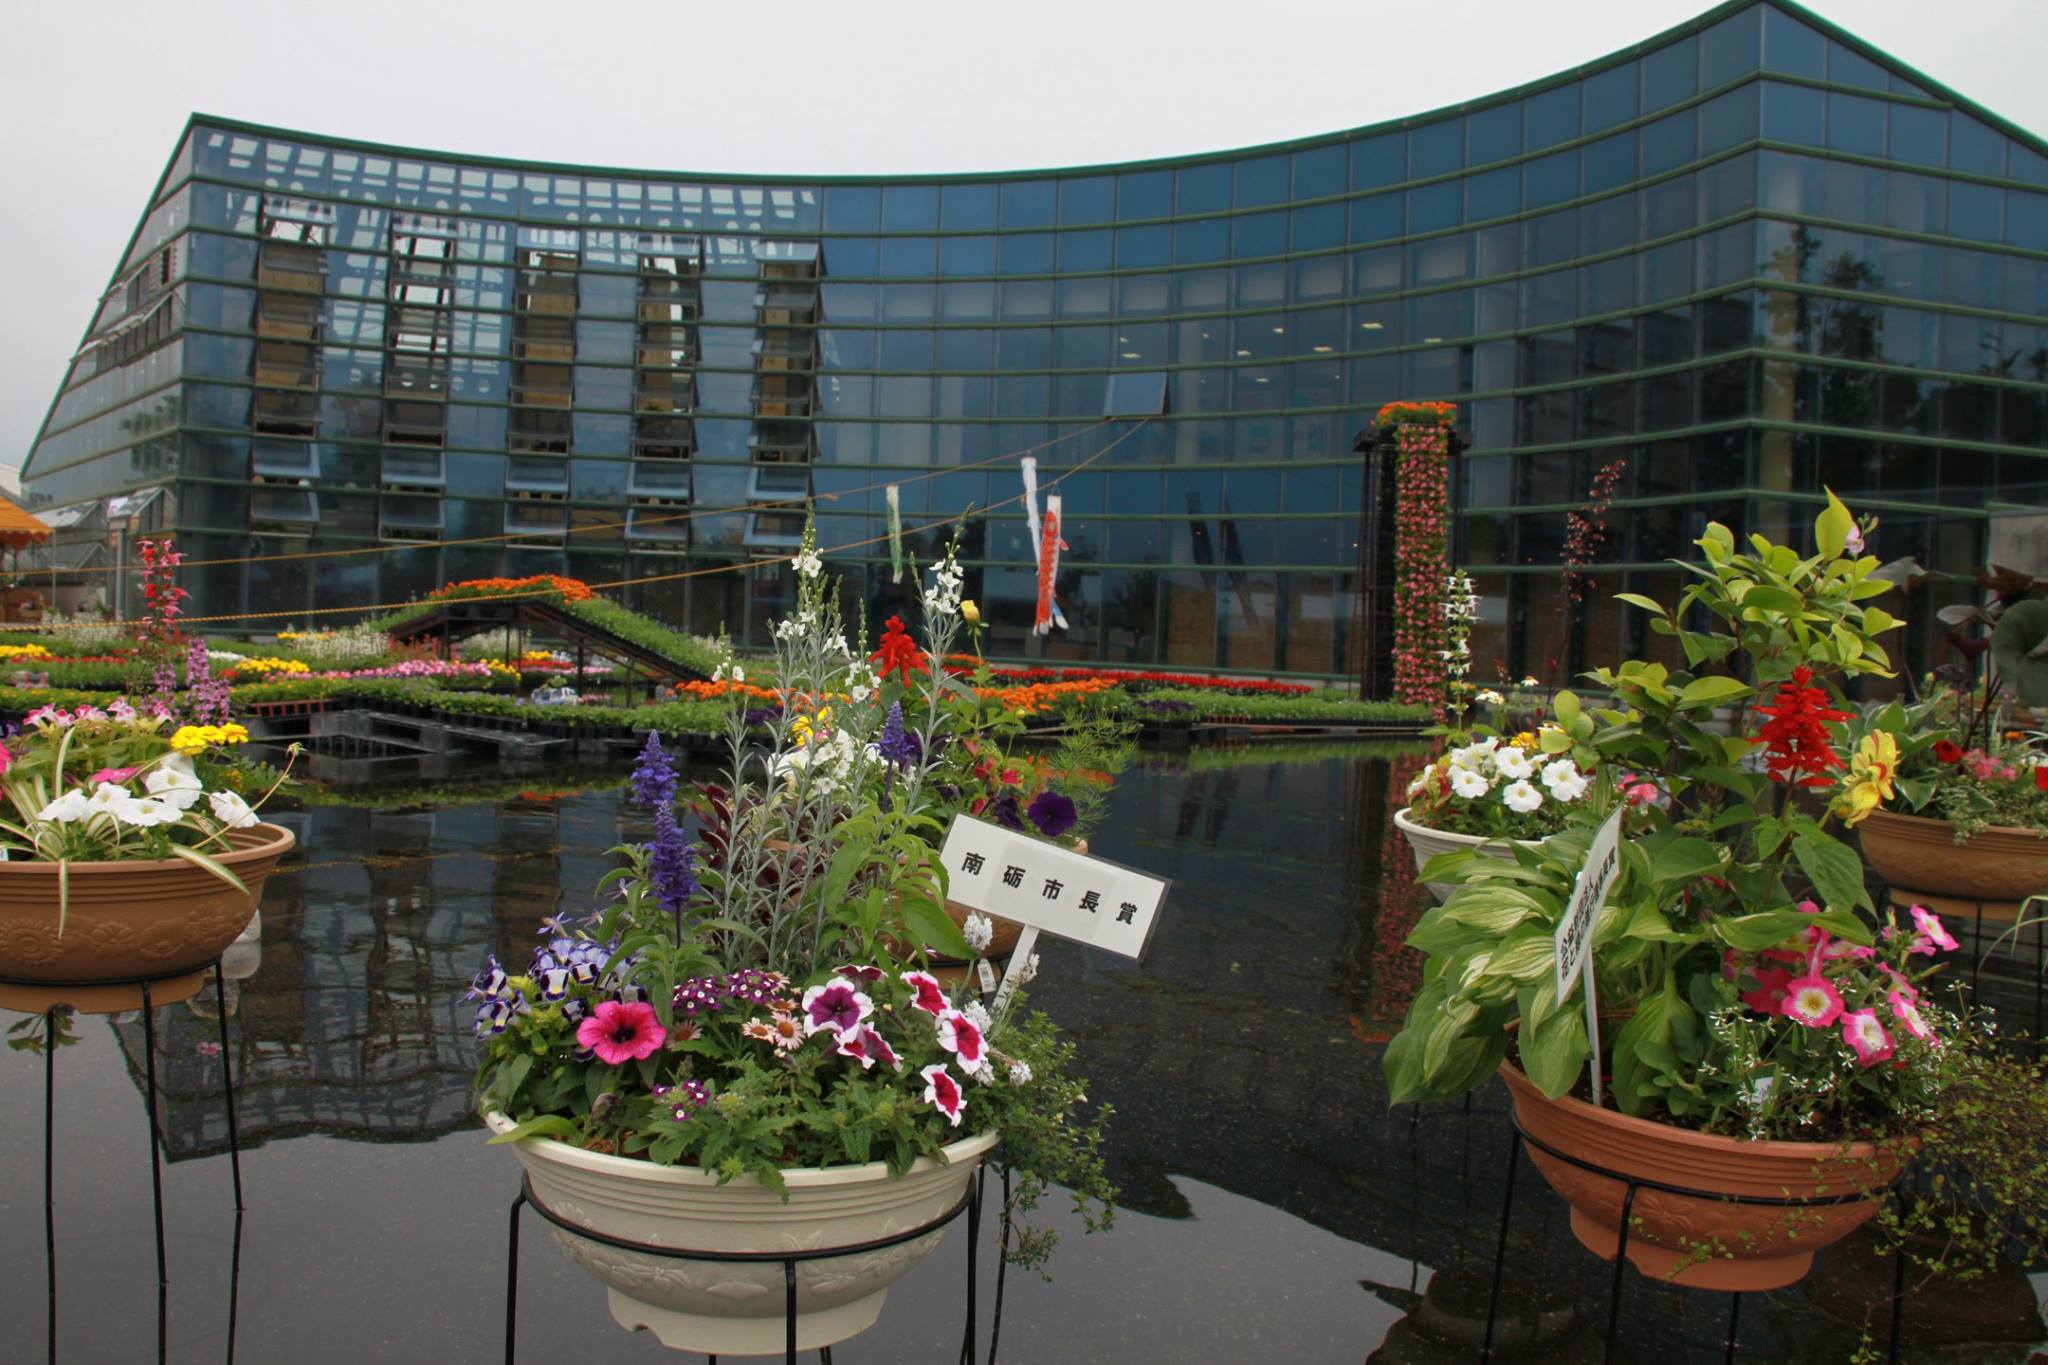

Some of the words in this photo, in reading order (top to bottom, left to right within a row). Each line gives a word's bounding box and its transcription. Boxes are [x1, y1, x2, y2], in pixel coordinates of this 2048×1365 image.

[961, 851, 1137, 925] 南砺市長賞
